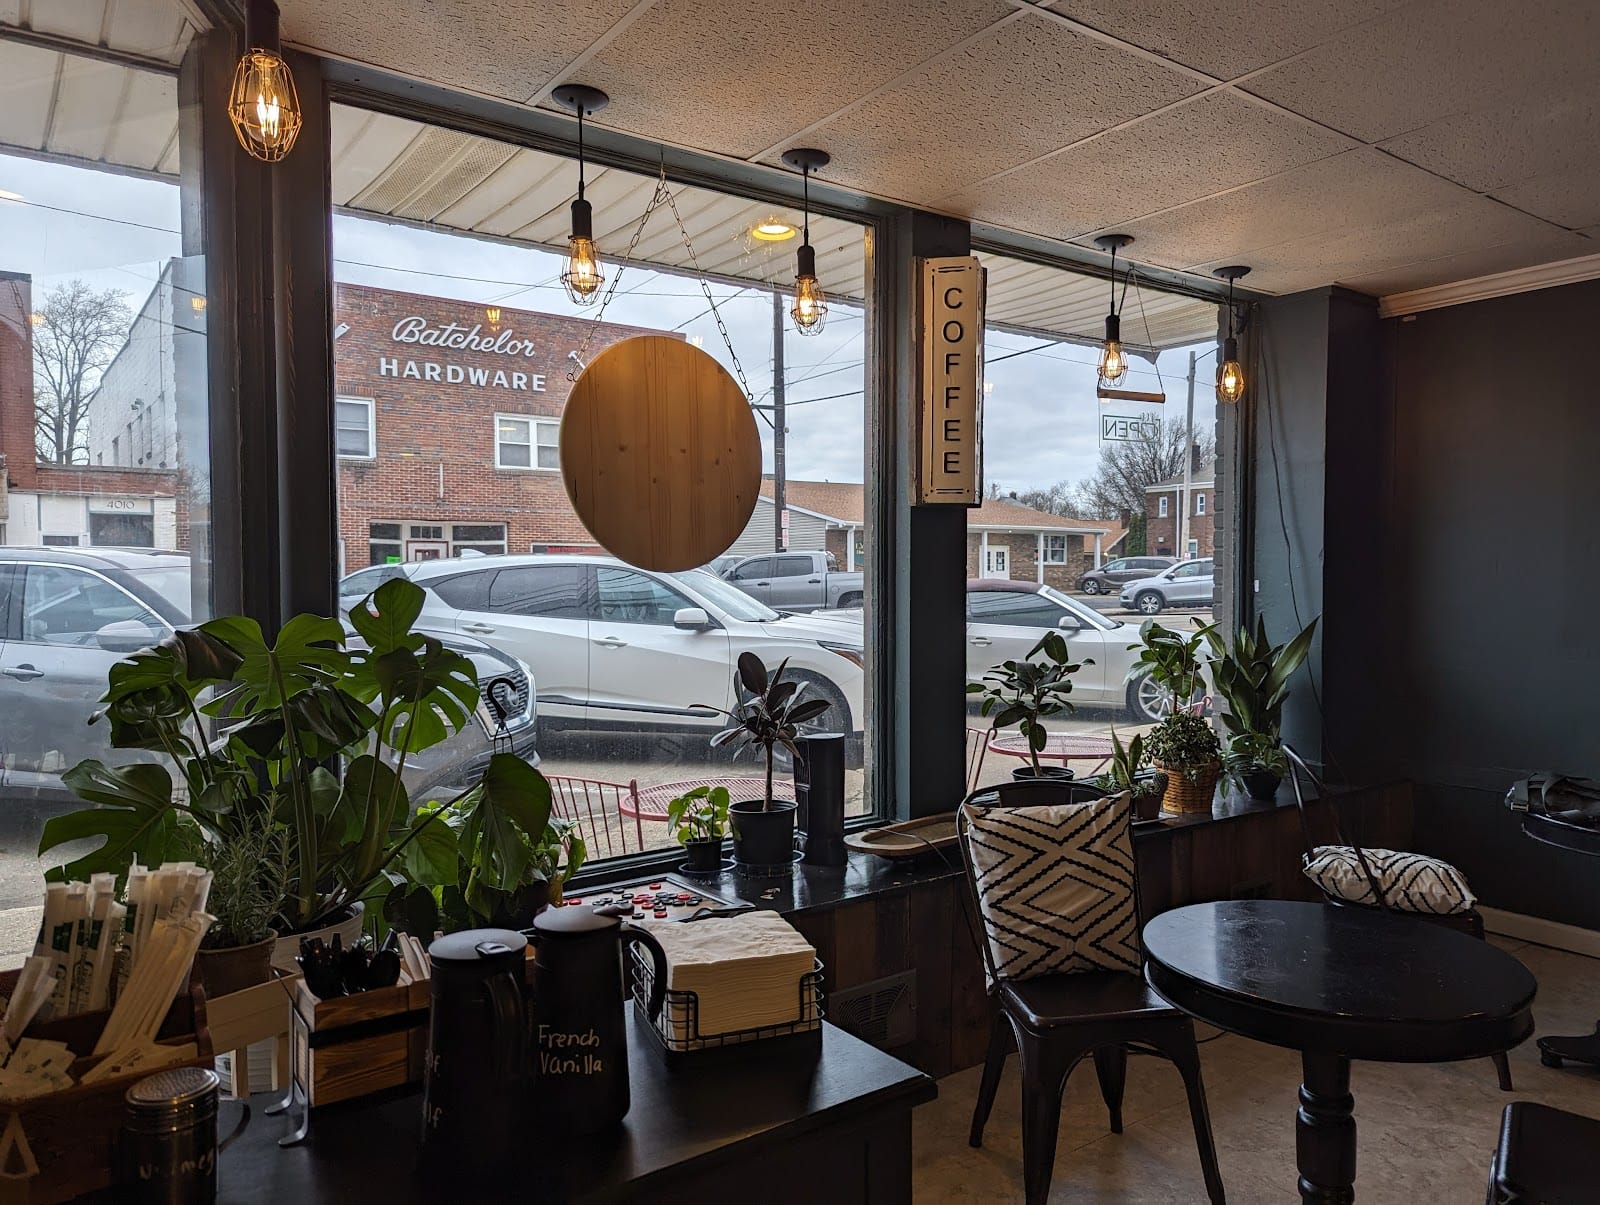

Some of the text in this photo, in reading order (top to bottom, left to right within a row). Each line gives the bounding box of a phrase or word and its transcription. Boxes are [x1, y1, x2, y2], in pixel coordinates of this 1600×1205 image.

[391, 316, 536, 358] Batchelor
[379, 357, 547, 392] HARDWARE
[942, 287, 965, 475] COFFEE
[106, 500, 135, 510] 4010
[537, 1024, 601, 1049] French
[539, 1051, 604, 1076] Vanilla
